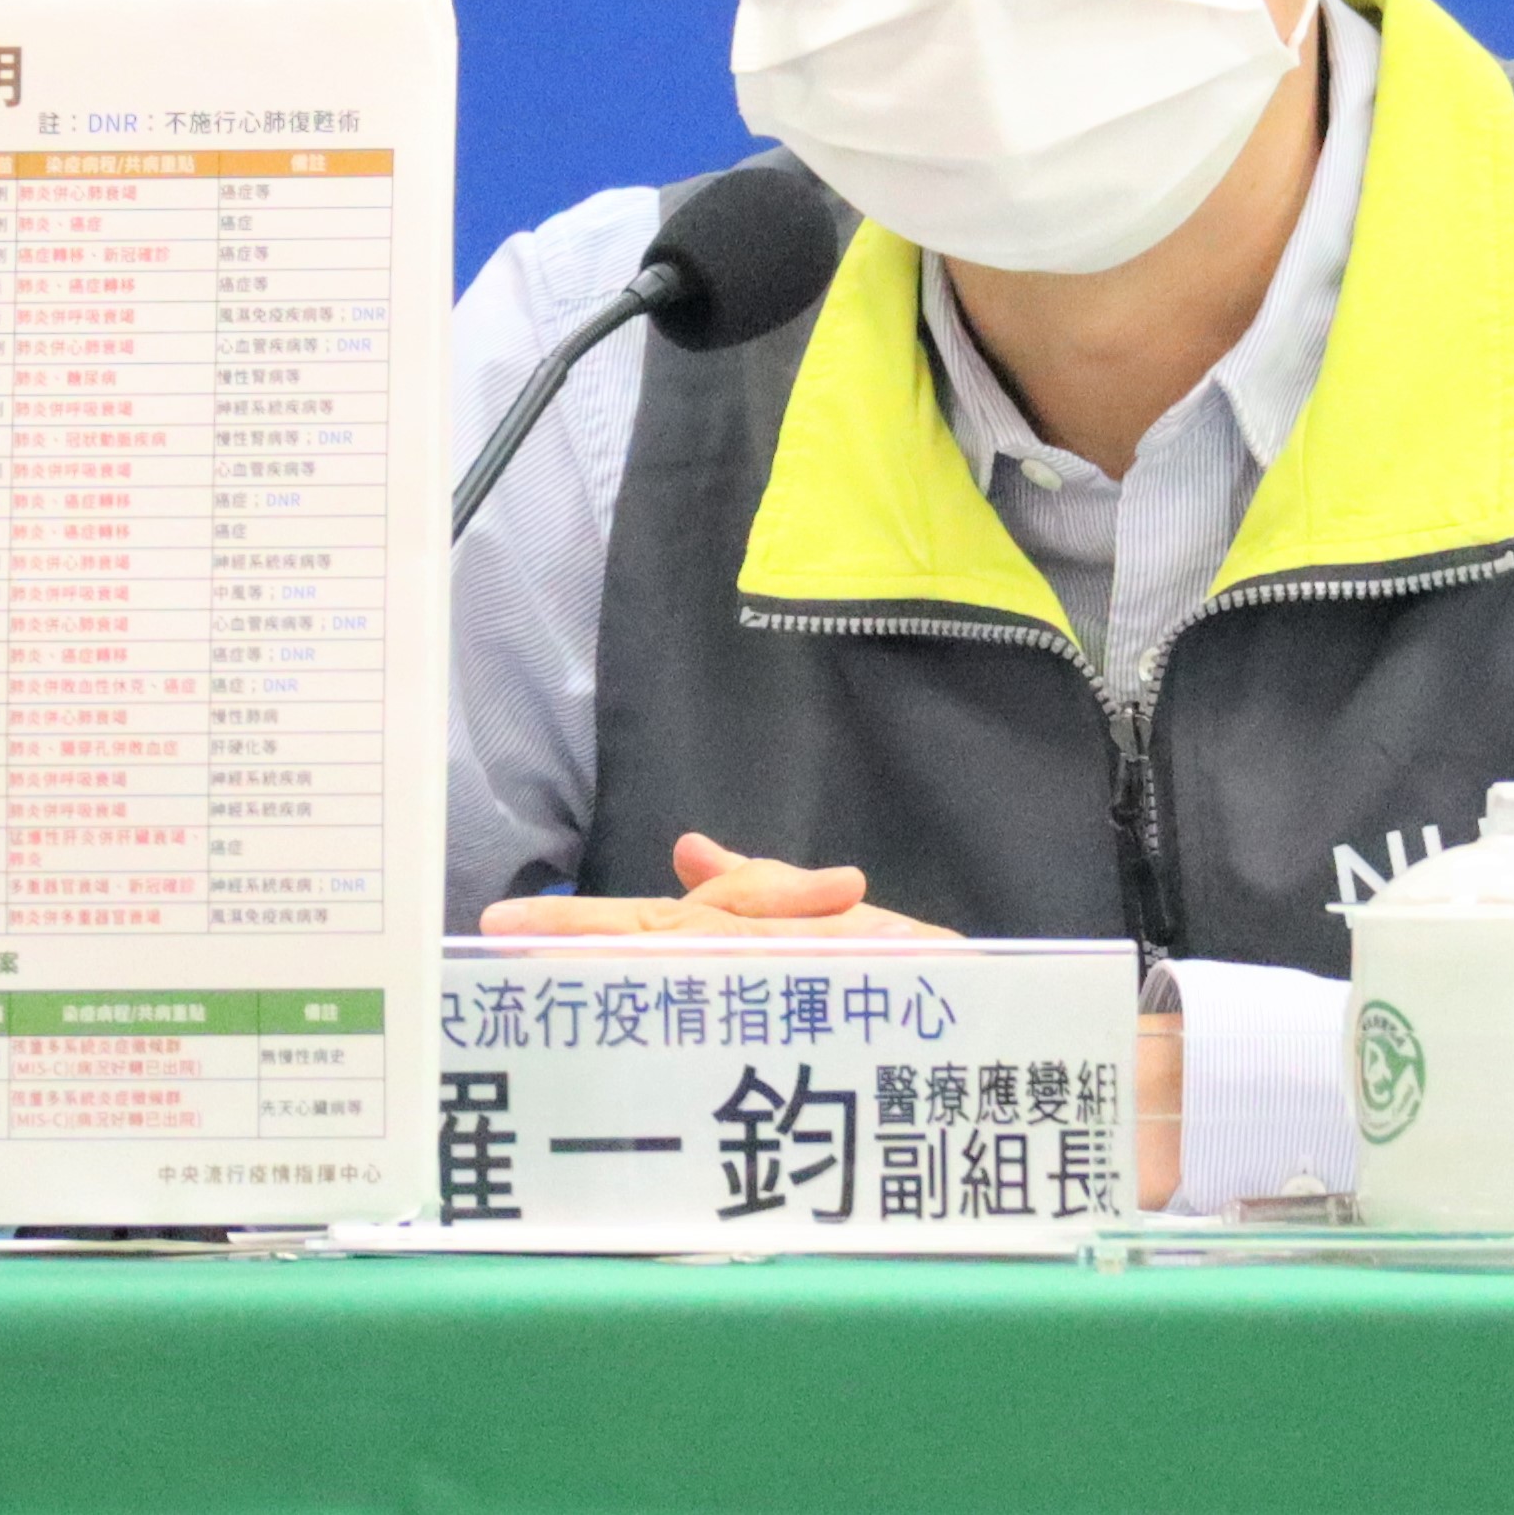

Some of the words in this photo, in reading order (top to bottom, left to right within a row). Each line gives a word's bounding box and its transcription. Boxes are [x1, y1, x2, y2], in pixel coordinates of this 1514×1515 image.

[290, 154, 326, 172] 備註
[220, 185, 271, 201] 癌症等
[220, 214, 254, 232] 癌症
[874, 1060, 1118, 1126] 醫療應變組
[158, 1163, 382, 1185] 中央流行疫情指揮中心
[874, 1127, 1121, 1223] 副組長
